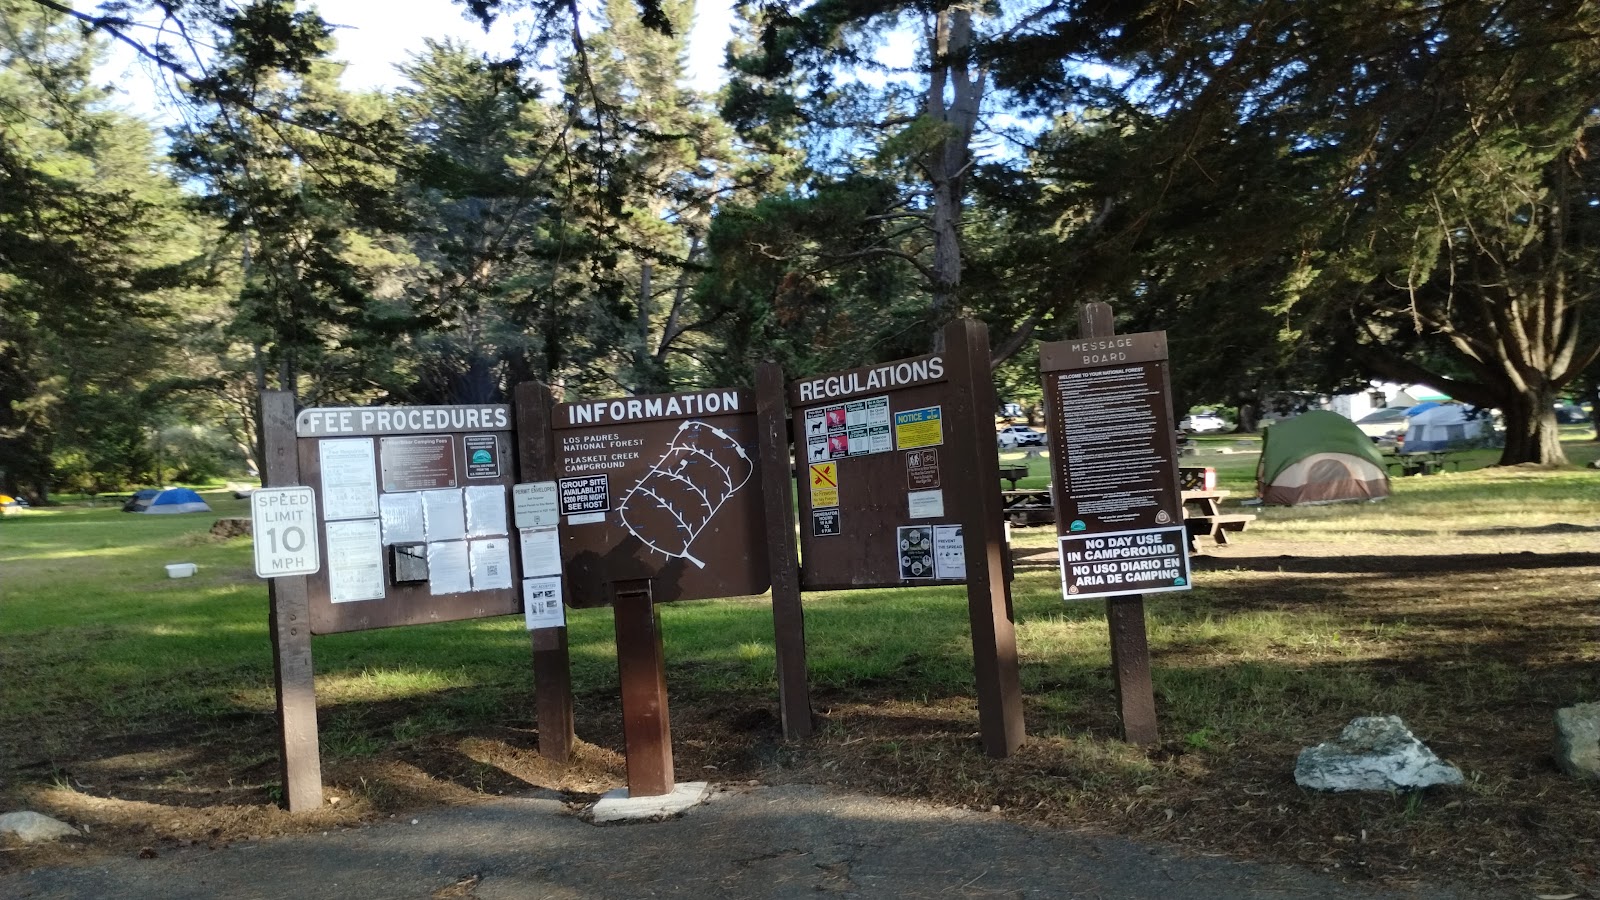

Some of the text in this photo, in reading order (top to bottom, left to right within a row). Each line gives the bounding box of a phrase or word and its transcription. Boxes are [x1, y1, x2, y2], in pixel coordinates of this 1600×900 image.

[1071, 338, 1133, 352] MESSAGE
[1083, 352, 1126, 365] BOARD
[800, 356, 944, 401] REGULATIONS
[568, 391, 739, 424] INFORMATION
[310, 408, 507, 433] FEE PROCEDURES
[898, 412, 923, 424] NOTICE
[563, 433, 619, 445] LOS PADRES
[563, 439, 644, 452] NATIONAL FOREST
[564, 452, 639, 464] PLASKETT CREEK
[565, 461, 625, 472] CAMPGROUND
[561, 478, 606, 489] GROUP SITE
[563, 485, 605, 496] AVAILABILITY
[589, 493, 606, 501] NIGHT
[259, 494, 309, 507] SPEED
[568, 501, 603, 511] SEE HOST
[265, 511, 304, 522] LIMIT
[266, 526, 306, 554] 10
[1085, 533, 1162, 549] NO DAY USE
[1067, 543, 1176, 562] IN CAMPGROUND
[272, 557, 304, 569] MPH
[1072, 558, 1180, 576] NO USO DIARIO EN
[1076, 569, 1180, 586] ARIA DE CAMPING
